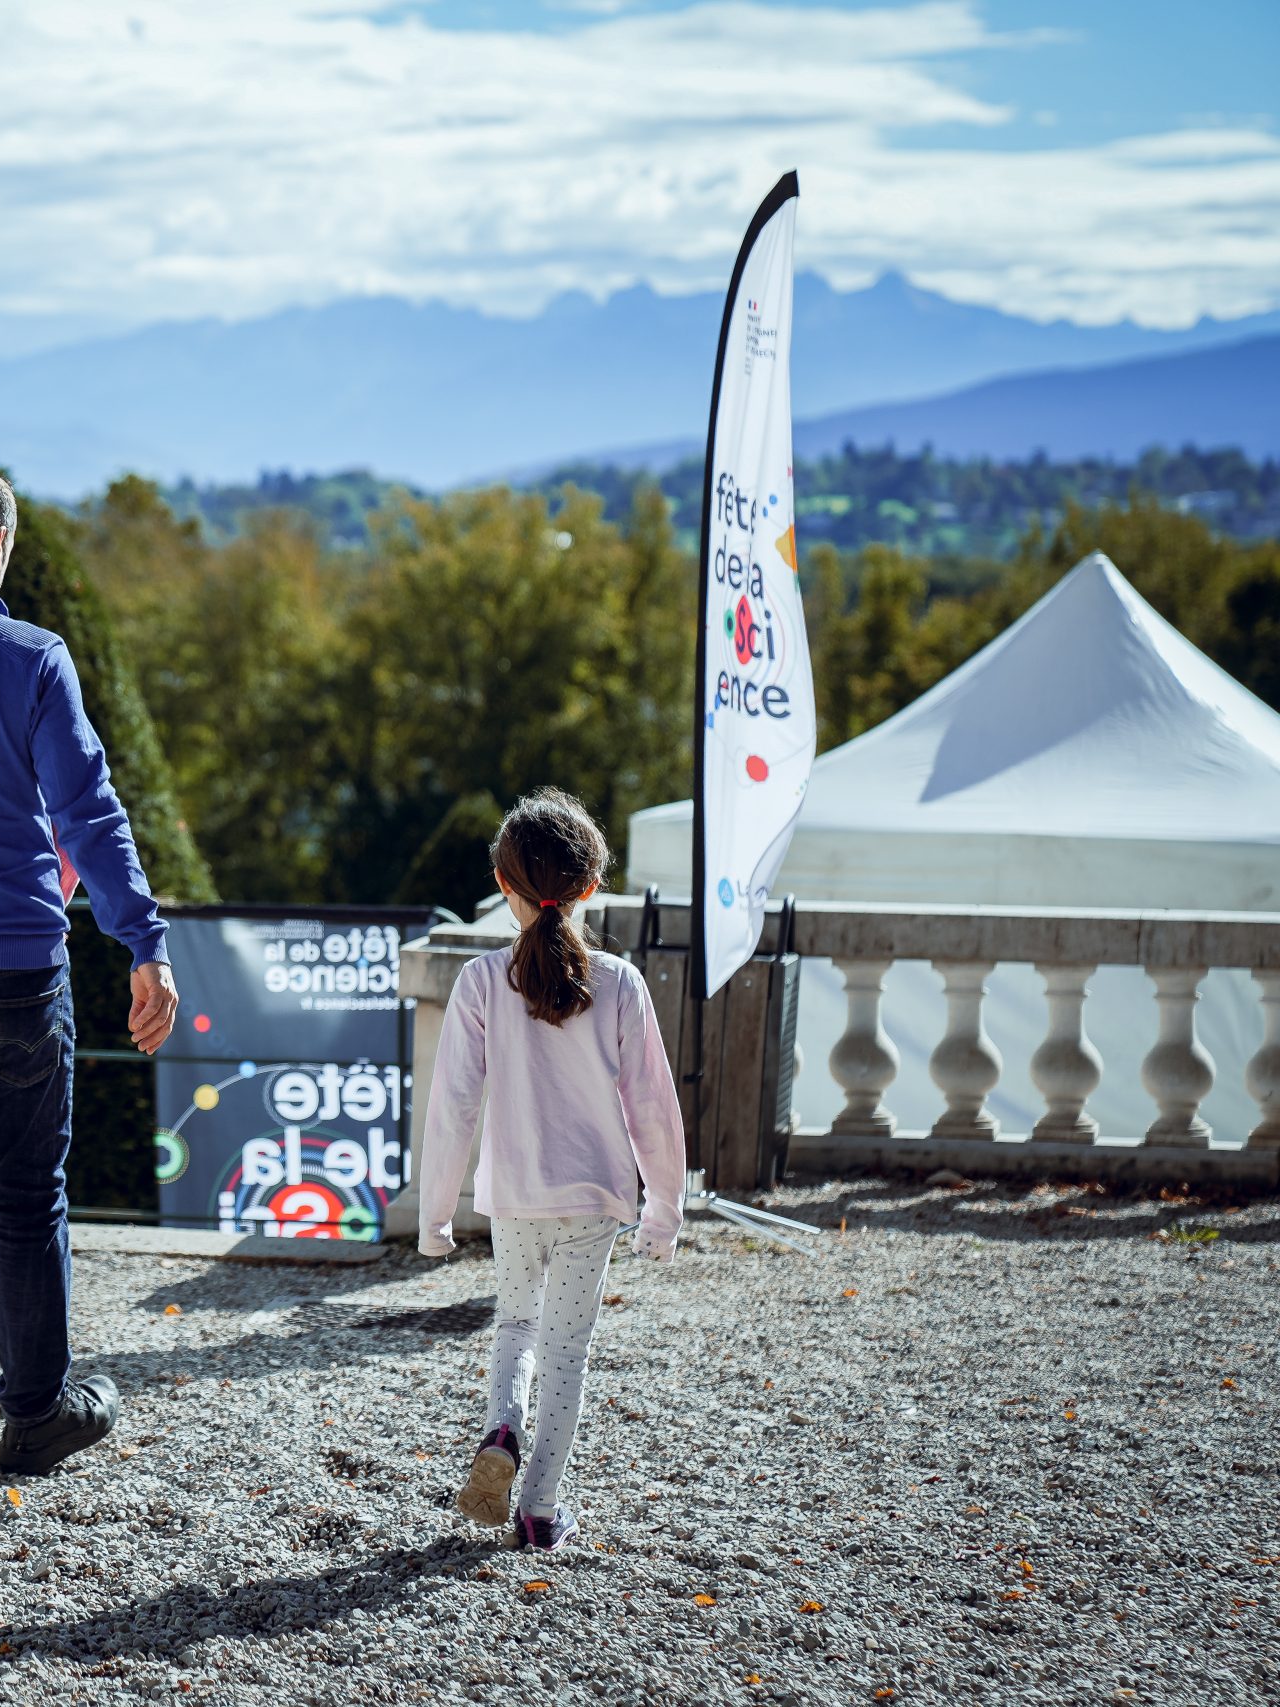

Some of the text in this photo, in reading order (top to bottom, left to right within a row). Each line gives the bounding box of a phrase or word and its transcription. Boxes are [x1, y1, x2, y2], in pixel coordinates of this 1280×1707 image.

[716, 472, 756, 535] fête
[715, 534, 764, 600] de la
[735, 603, 776, 660] Sci
[717, 670, 791, 719] ence
